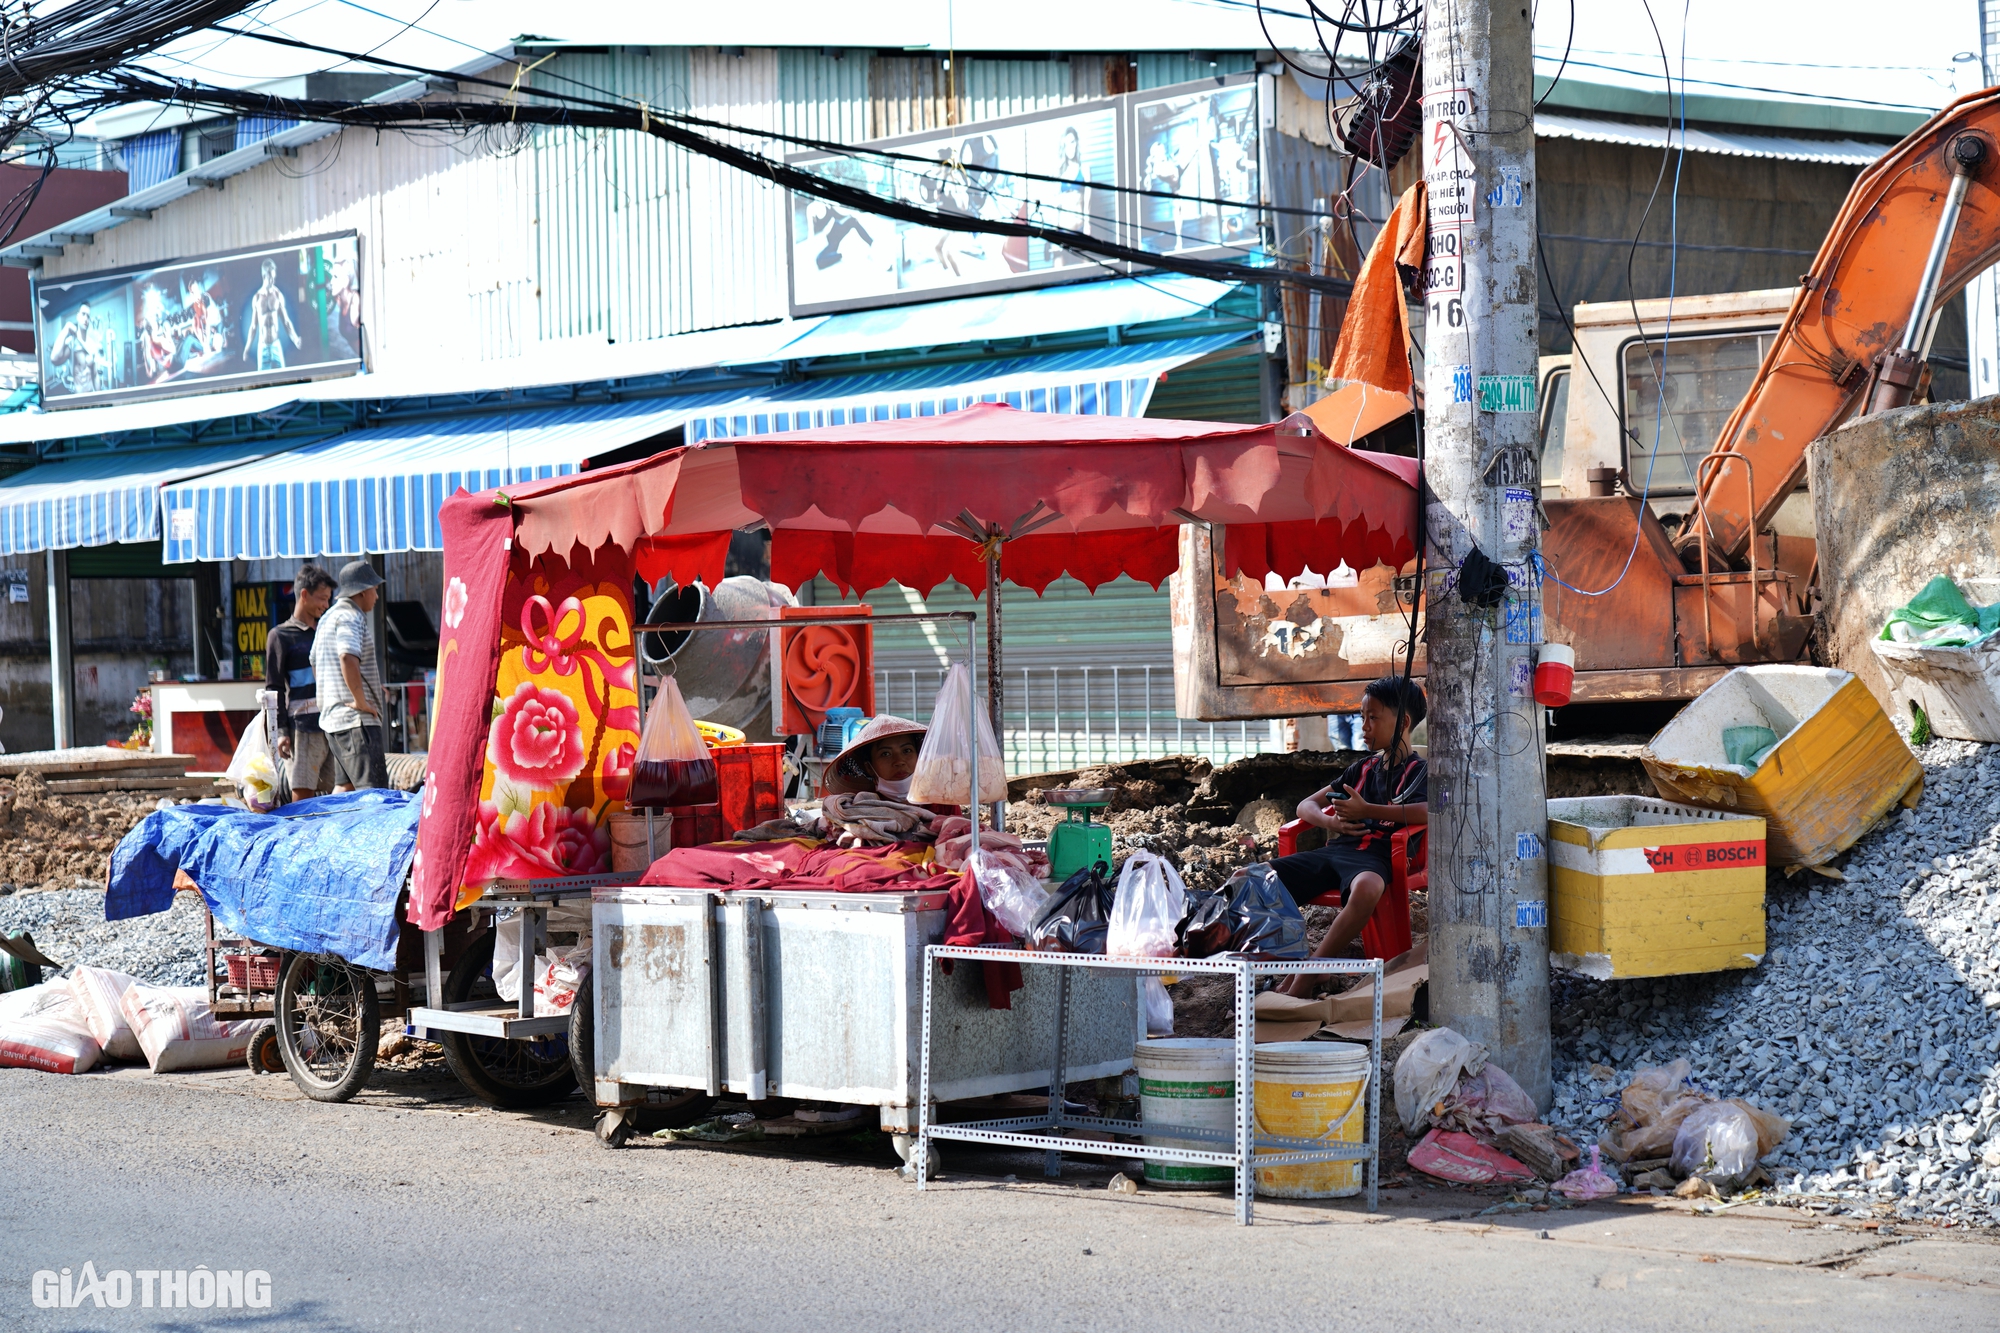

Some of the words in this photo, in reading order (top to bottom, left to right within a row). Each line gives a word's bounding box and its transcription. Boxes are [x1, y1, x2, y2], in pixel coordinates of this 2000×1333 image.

[1437, 97, 1466, 117] TRÈO
[1449, 169, 1471, 180] CAO
[1439, 182, 1465, 199] HIỂM
[235, 587, 268, 618] MAX
[237, 621, 268, 653] GYM
[1706, 846, 1757, 862] BOSCH
[1305, 1090, 1342, 1098] KoreShield
